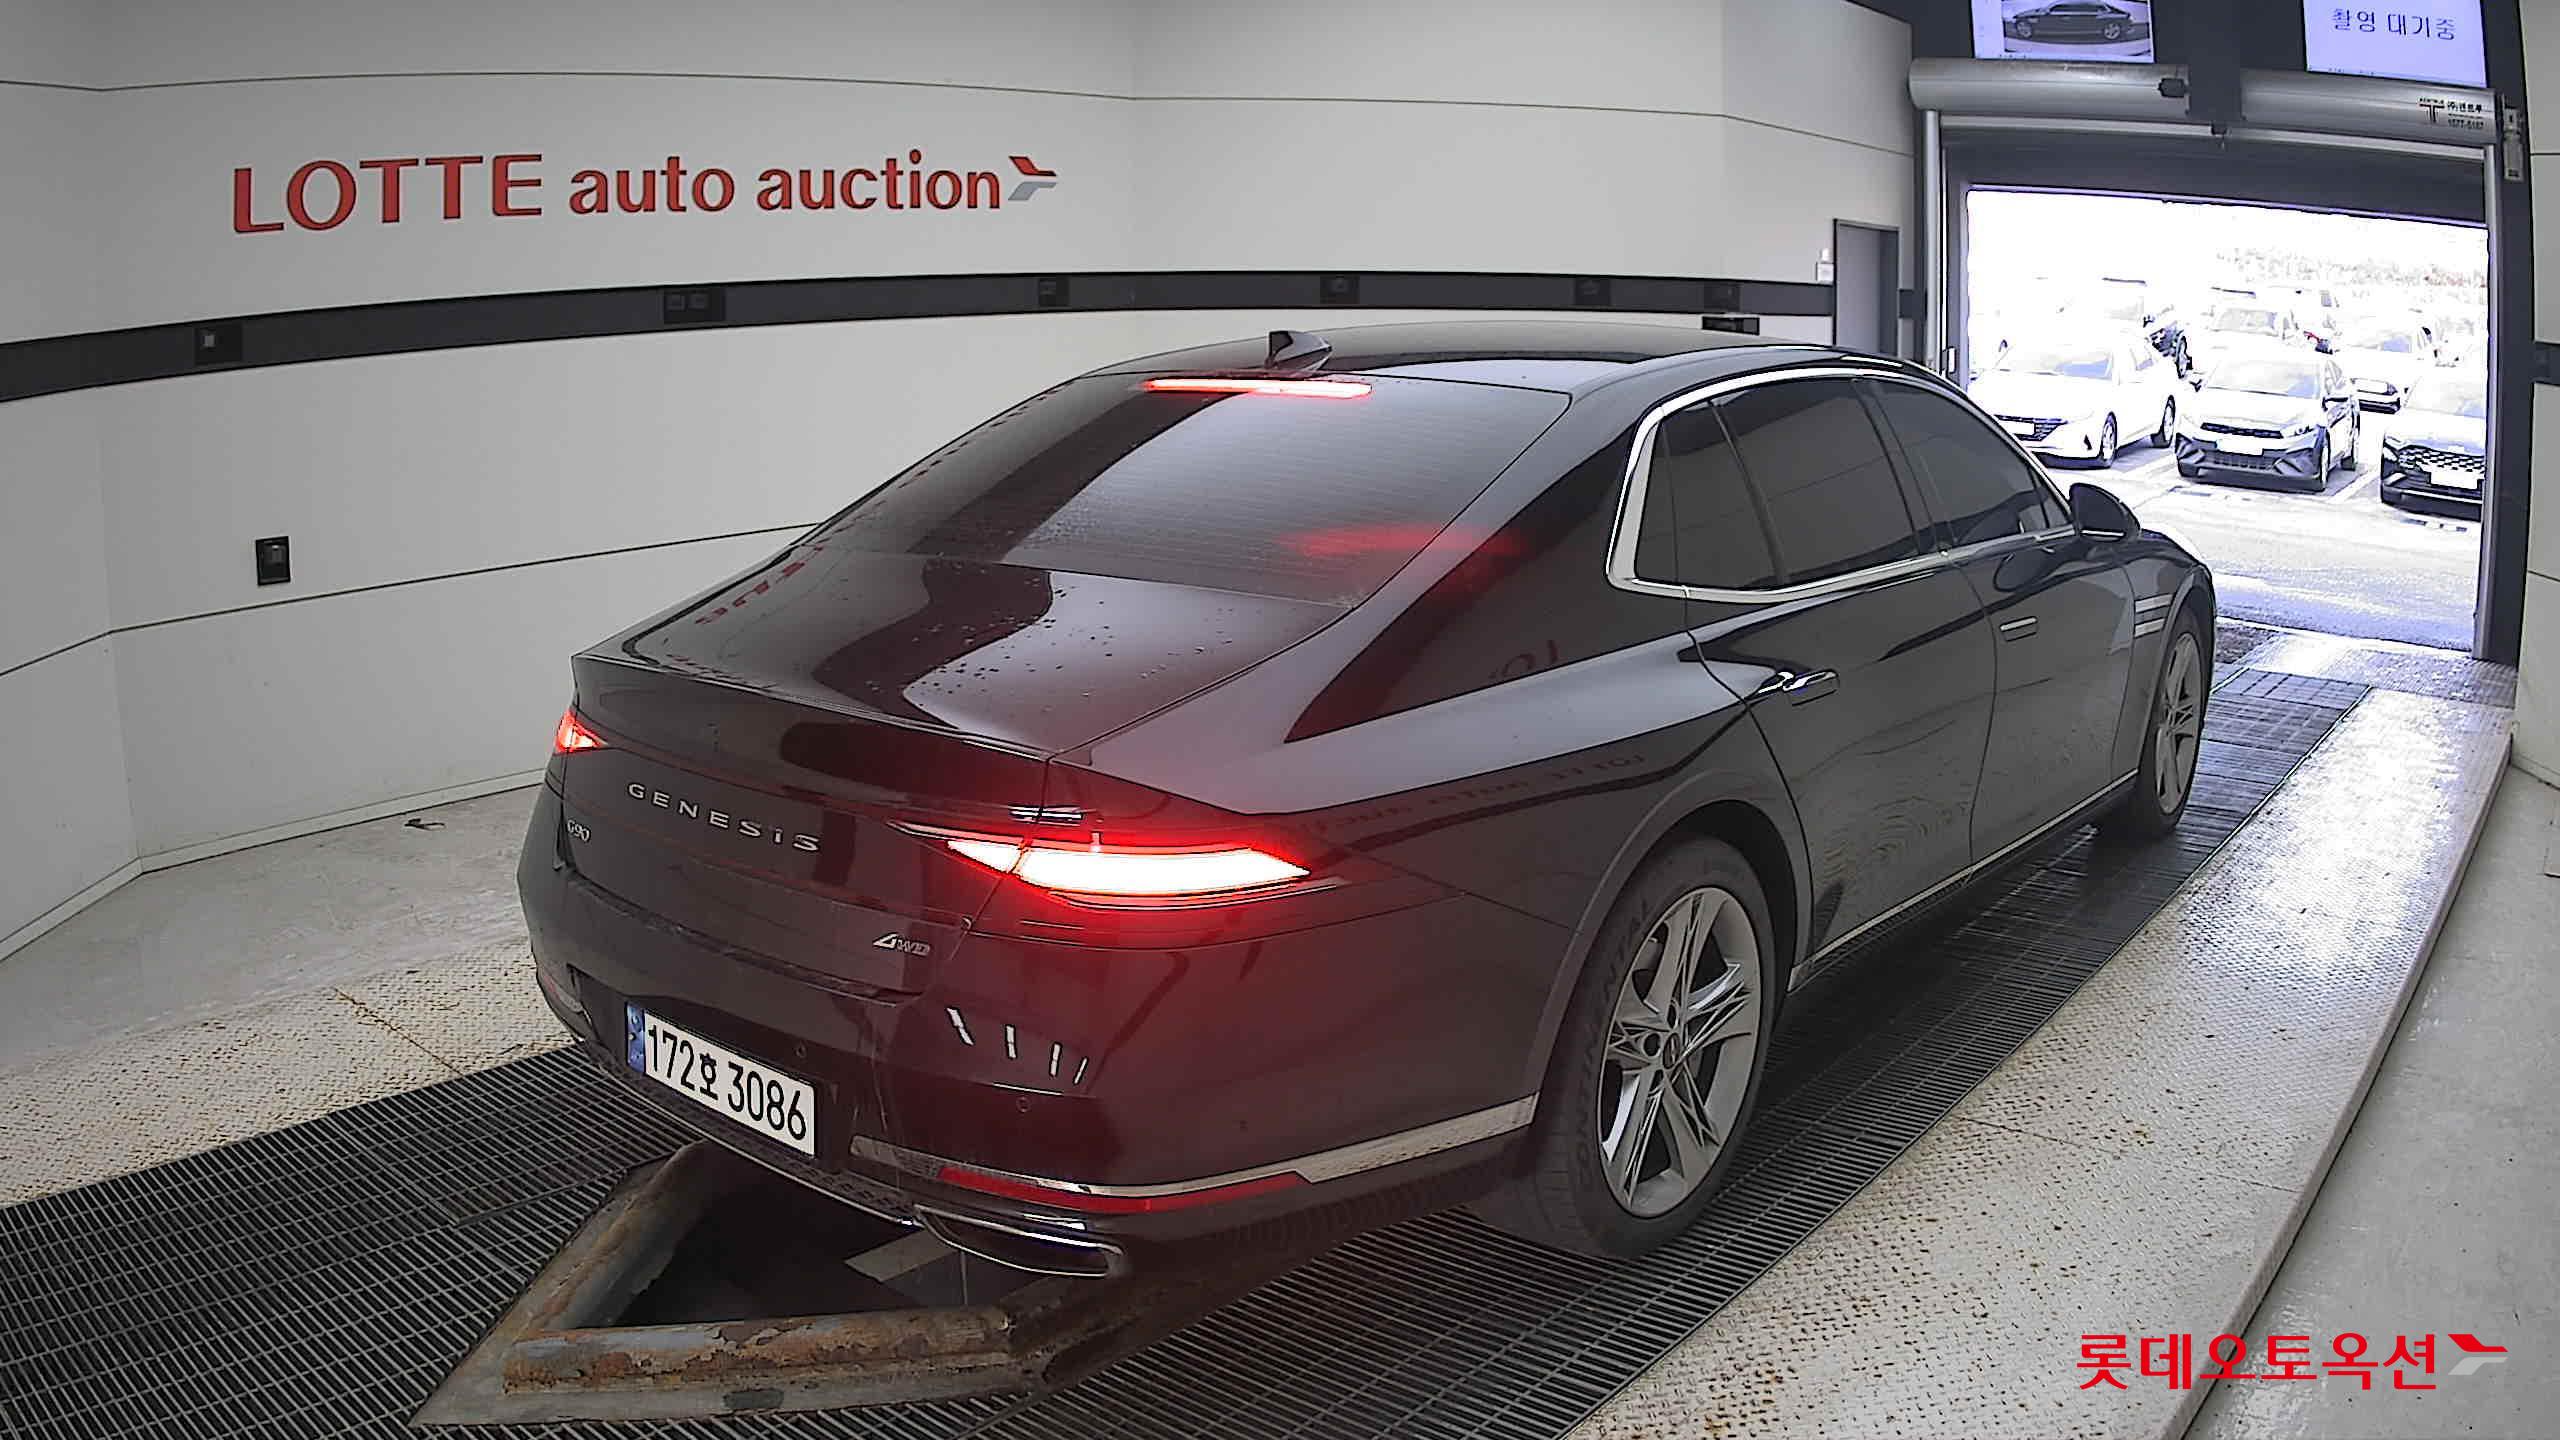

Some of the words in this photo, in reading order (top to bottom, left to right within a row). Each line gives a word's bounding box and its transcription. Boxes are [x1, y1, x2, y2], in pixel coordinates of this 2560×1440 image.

[2331, 8, 2377, 33] 촬영
[2386, 13, 2455, 41] 대기중
[234, 154, 542, 233] LOTTE
[569, 156, 735, 214] auto
[756, 150, 1002, 210] auction
[627, 783, 819, 851] GENESIS
[872, 933, 931, 956] 4WD
[648, 1024, 718, 1100] 172호
[727, 1061, 806, 1140] 3086
